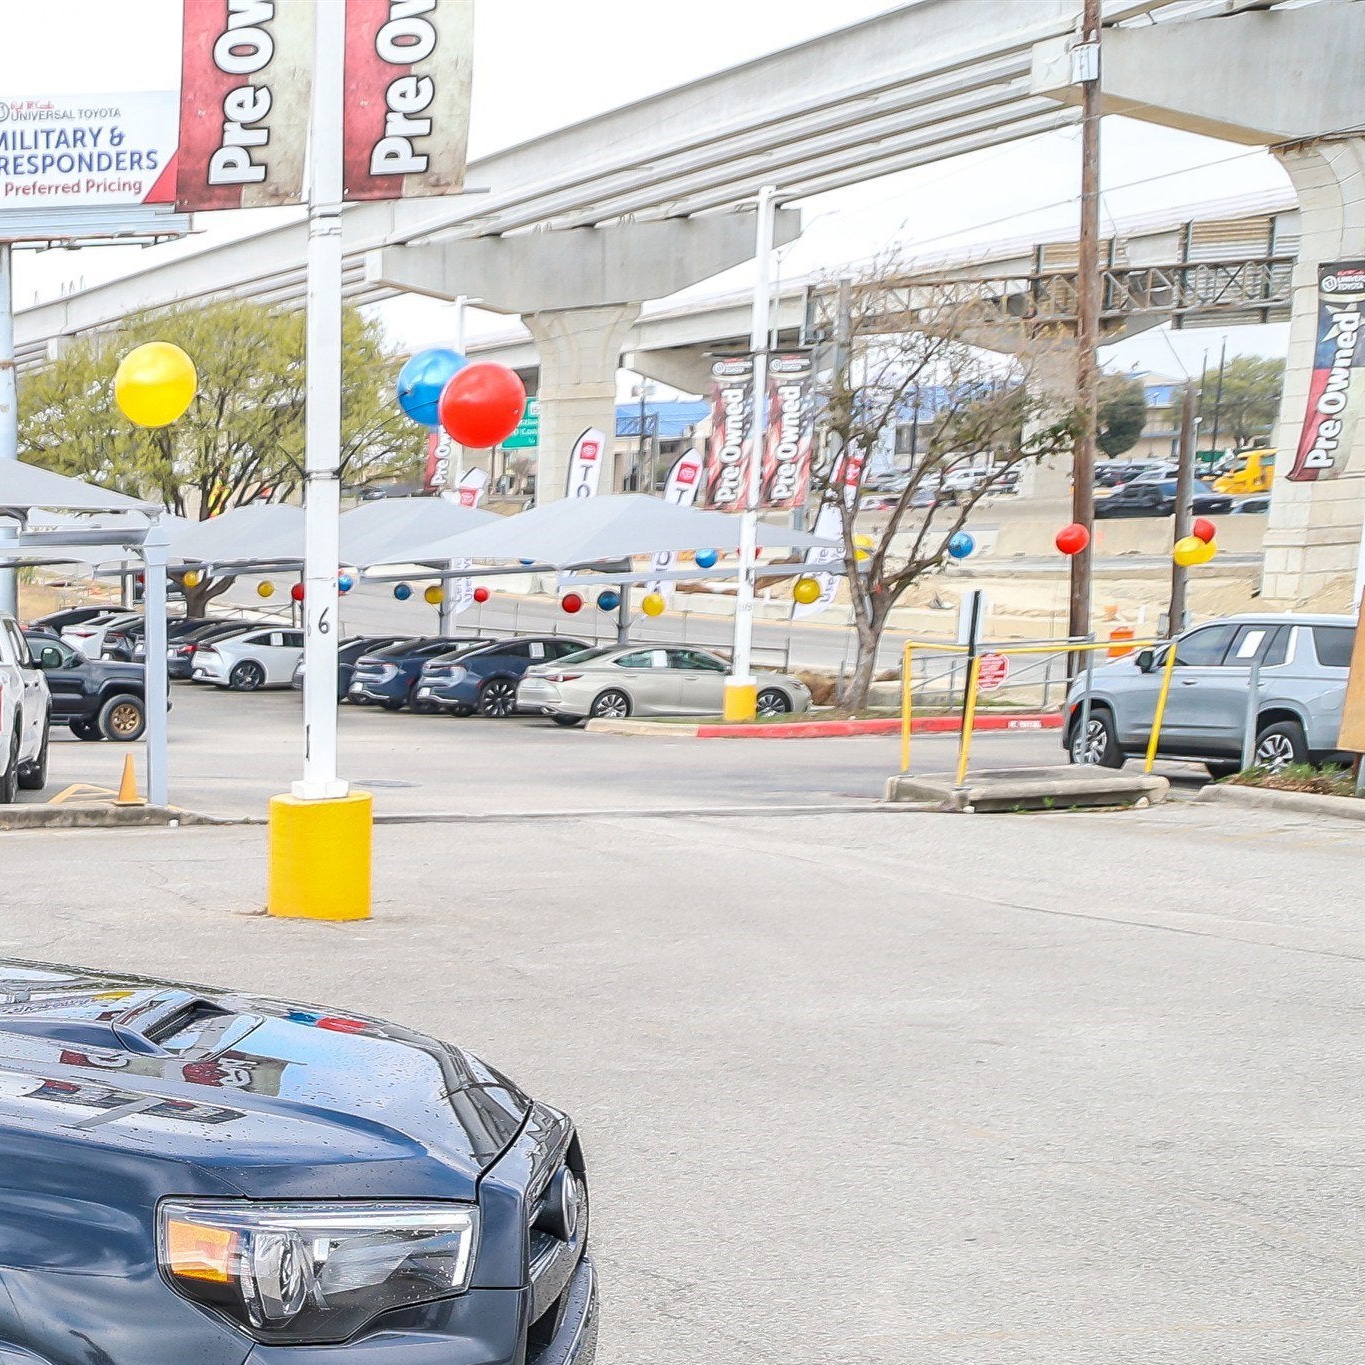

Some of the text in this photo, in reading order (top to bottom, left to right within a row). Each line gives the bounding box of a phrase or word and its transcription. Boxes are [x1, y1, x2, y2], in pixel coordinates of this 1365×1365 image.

[11, 107, 122, 122] UNIVERSAL TOYOTA
[370, 75, 435, 176] Pre
[109, 125, 126, 147] &
[208, 85, 273, 185] Pre
[4, 178, 81, 197] Preferred
[85, 177, 143, 196] Pricing
[1317, 311, 1362, 415] Owned
[1303, 418, 1343, 469] Pre
[318, 606, 330, 635] 6
